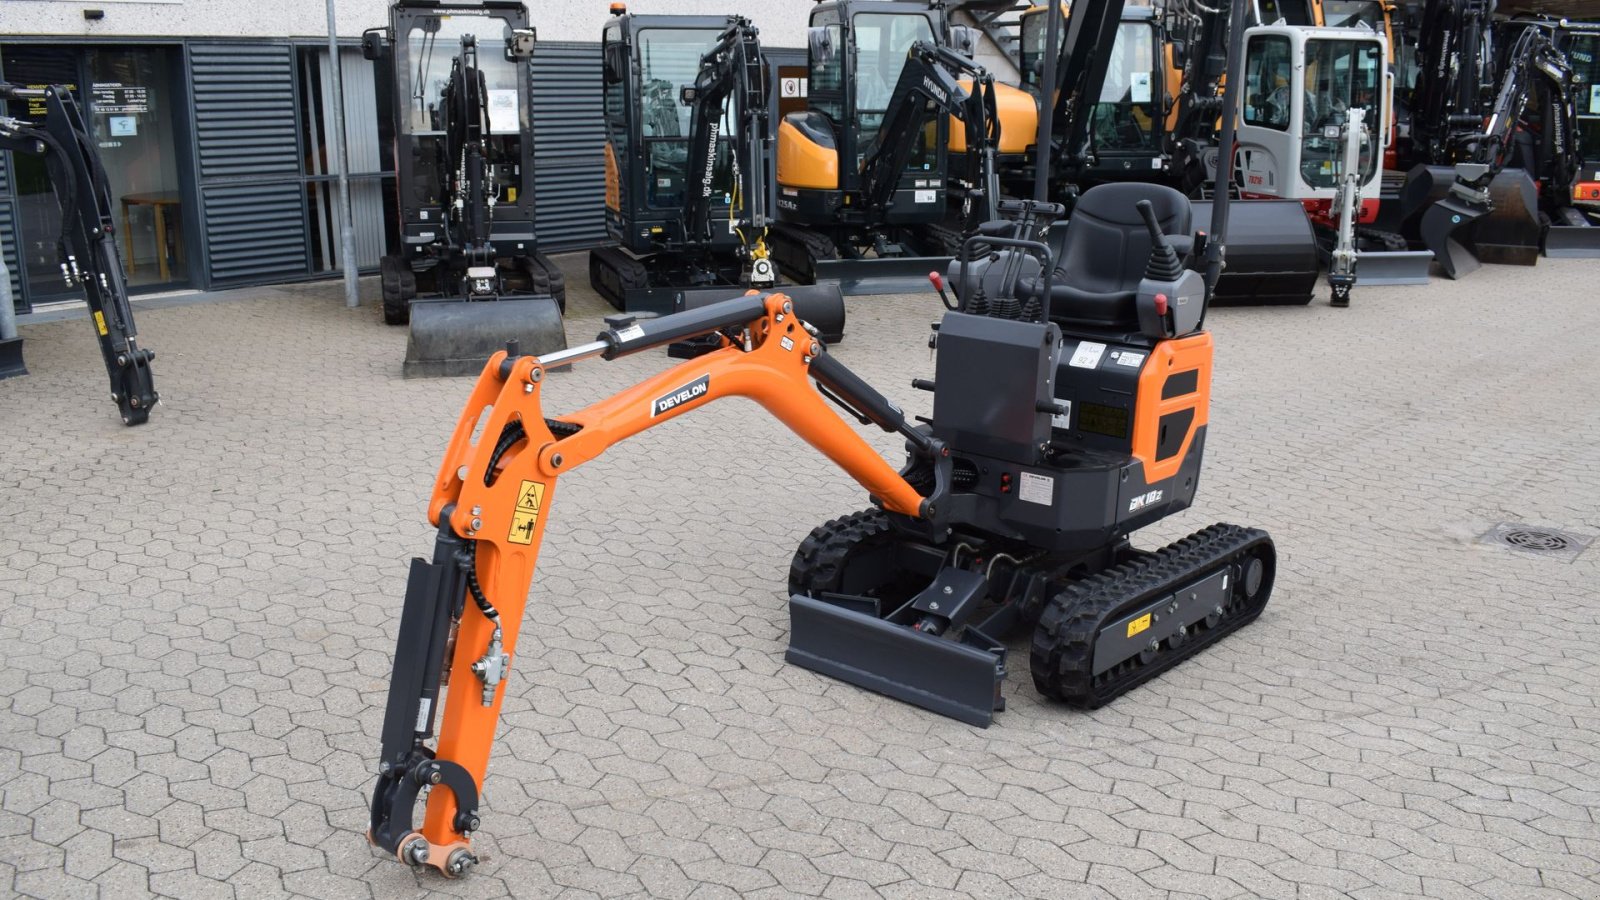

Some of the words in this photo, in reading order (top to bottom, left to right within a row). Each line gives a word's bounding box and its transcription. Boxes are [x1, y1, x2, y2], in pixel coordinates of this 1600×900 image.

[923, 75, 947, 103] HYUNDAI
[702, 122, 720, 197] phmaskinsalg.dk
[658, 382, 707, 412] DEVELON
